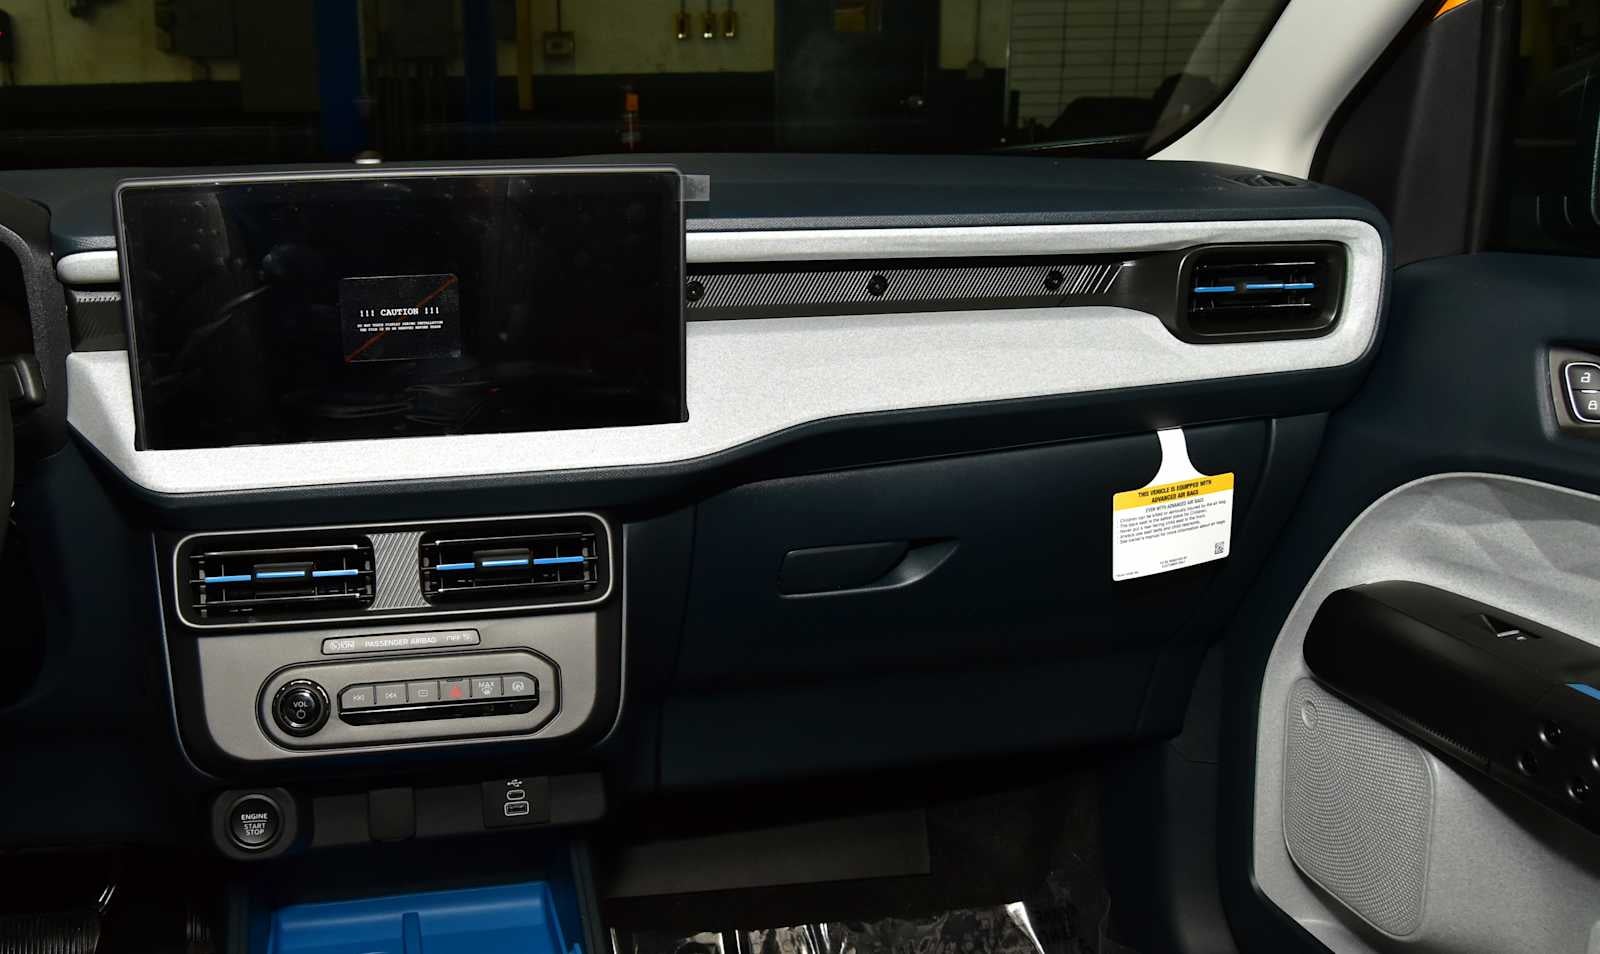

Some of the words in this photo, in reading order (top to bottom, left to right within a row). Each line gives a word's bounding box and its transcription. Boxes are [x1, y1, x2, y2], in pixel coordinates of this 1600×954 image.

[380, 308, 418, 316] CAUTION
[1150, 488, 1170, 496] VEHICLE
[1177, 481, 1198, 491] EQUIPPED
[1152, 494, 1176, 502] ADVANCED
[365, 639, 408, 648] PASSENGER
[410, 637, 436, 645] AIRBAG
